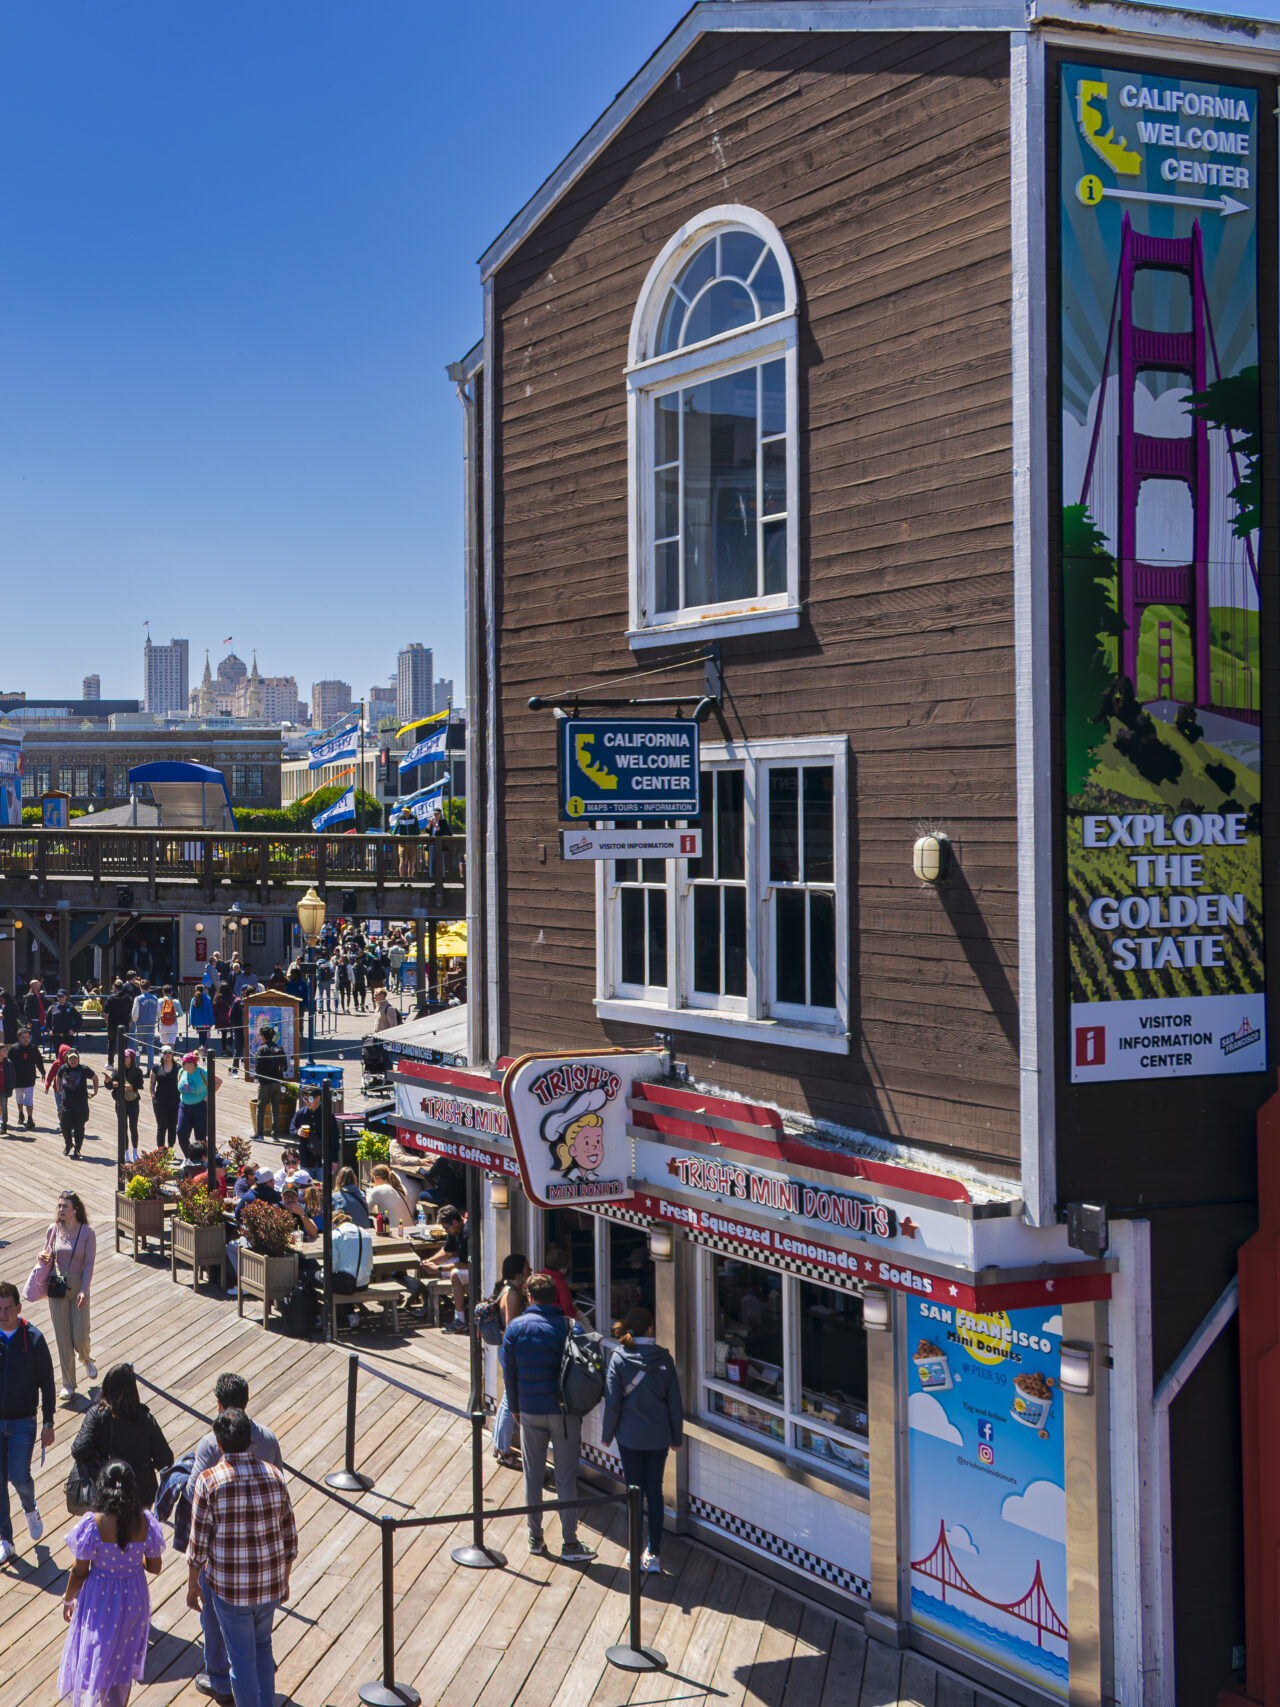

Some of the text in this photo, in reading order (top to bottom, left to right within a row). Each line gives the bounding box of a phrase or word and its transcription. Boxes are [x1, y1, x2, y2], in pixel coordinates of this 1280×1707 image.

[1120, 85, 1250, 122] CALIFORNIA
[1136, 121, 1249, 155] WELCOME
[1161, 158, 1249, 189] CENTER
[603, 733, 689, 748] CALIFORNIA
[615, 754, 690, 768] WELCOME
[631, 776, 690, 790] CENTER
[587, 803, 608, 812] MAPS
[614, 803, 639, 811] TOURS
[643, 803, 692, 812] INFORMATION
[599, 842, 625, 850] VISITOR
[626, 841, 674, 850] INFORMATION
[1083, 813, 1249, 848] EXPLORE
[1129, 855, 1205, 887] THE
[1089, 893, 1245, 930] GOLDEN
[1111, 935, 1225, 971] STATE
[1139, 1014, 1192, 1029] VISITOR
[1119, 1032, 1213, 1050] INFORMATION
[1221, 1033, 1236, 1046] SAN
[1225, 1031, 1261, 1054] FRANCISCO
[1140, 1053, 1192, 1068] CENTER
[528, 1063, 622, 1105] TRISH'S
[426, 1097, 508, 1138] TRISH'S MINI
[416, 1133, 458, 1156] Gourmet
[459, 1145, 492, 1165] Coffee
[549, 1182, 624, 1199] MINI DONUTS
[676, 1156, 892, 1239] TRISH'S MINI DONUTS
[659, 1200, 933, 1294] Fresh Squeezed Lemonade Sodas
[920, 1302, 1052, 1354] SAN FRANCISCO
[947, 1330, 1023, 1364] Mini Donuts
[975, 1408, 987, 1417] and
